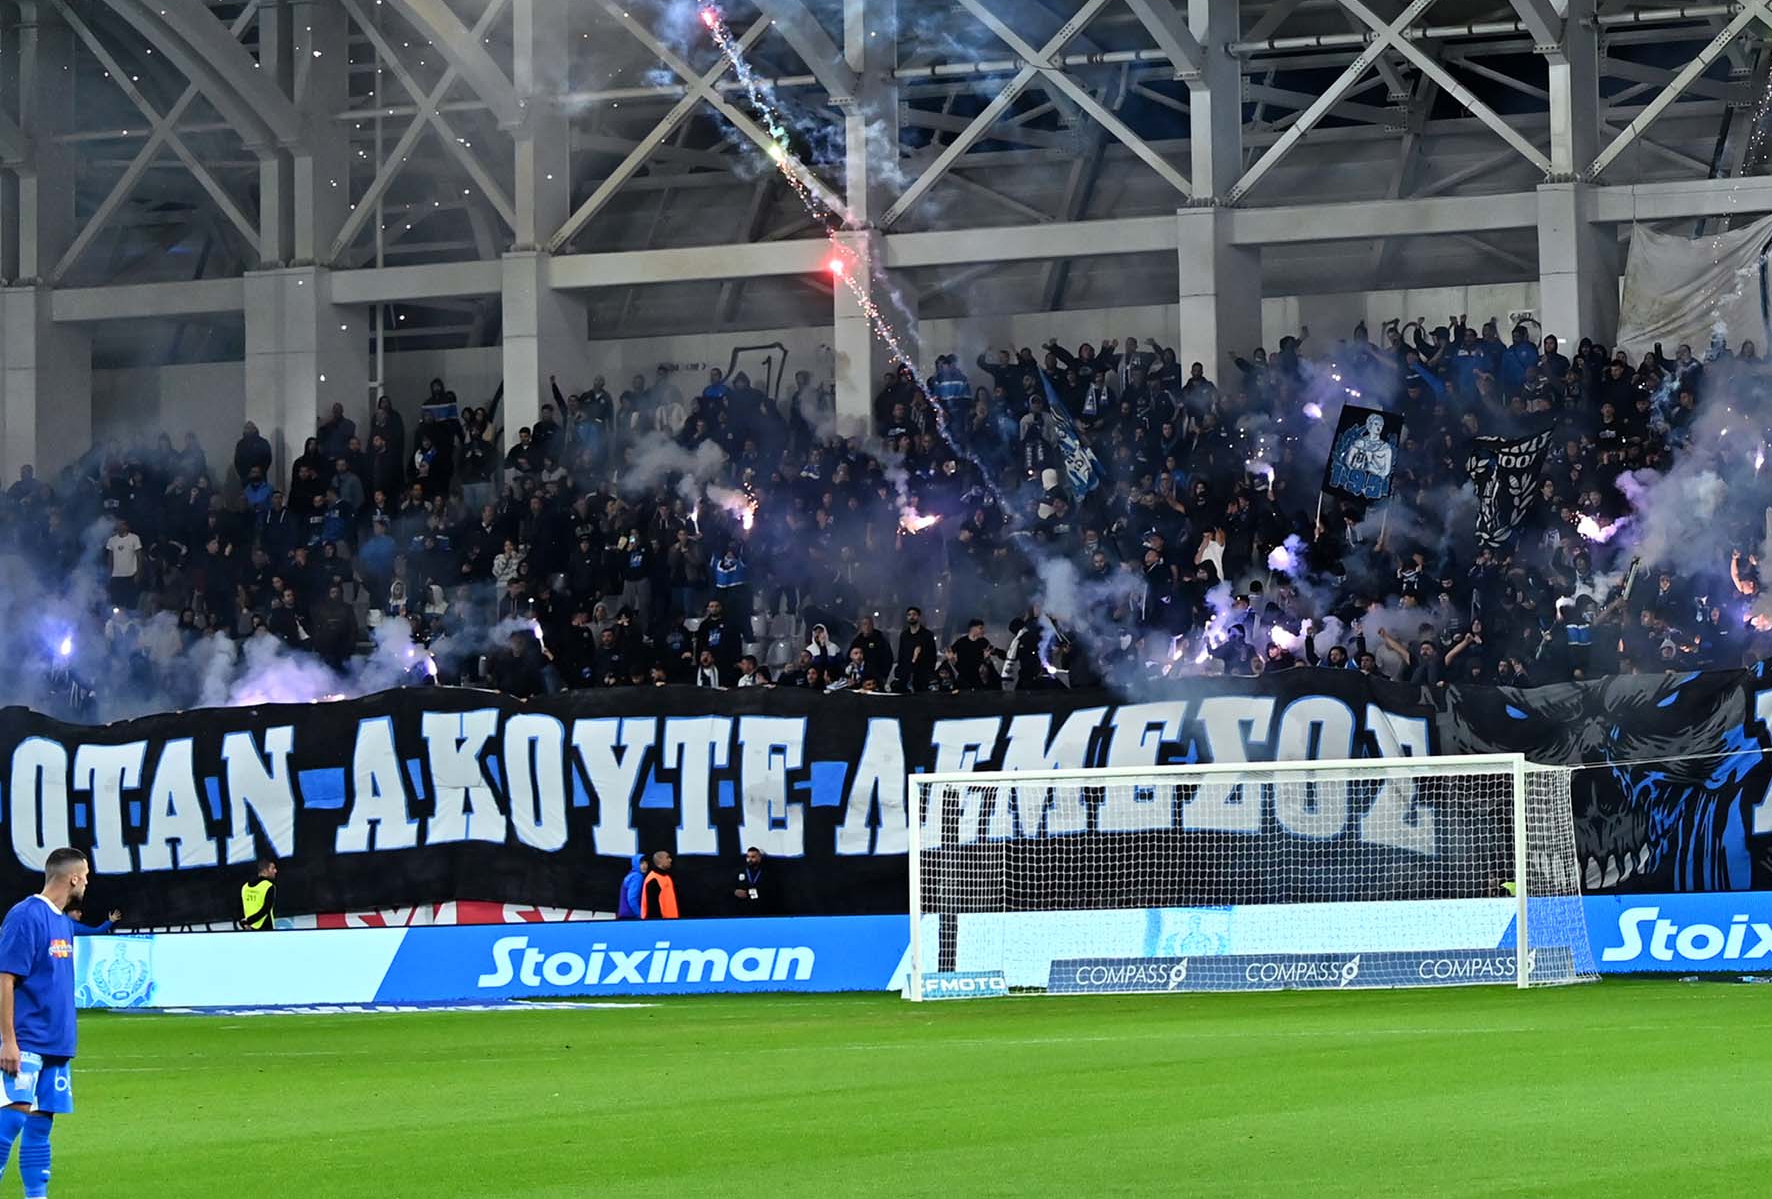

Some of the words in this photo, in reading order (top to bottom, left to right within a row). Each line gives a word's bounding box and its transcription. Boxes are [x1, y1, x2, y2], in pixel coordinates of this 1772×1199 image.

[10, 725, 294, 874] ΟΤΑΝ
[335, 708, 806, 857] ΑΚΟΥΤΕ
[478, 935, 816, 989] Stoiximan
[1245, 962, 1341, 982] COMPASS
[1418, 957, 1516, 978] COMPASS
[1075, 964, 1168, 986] COMPASS
